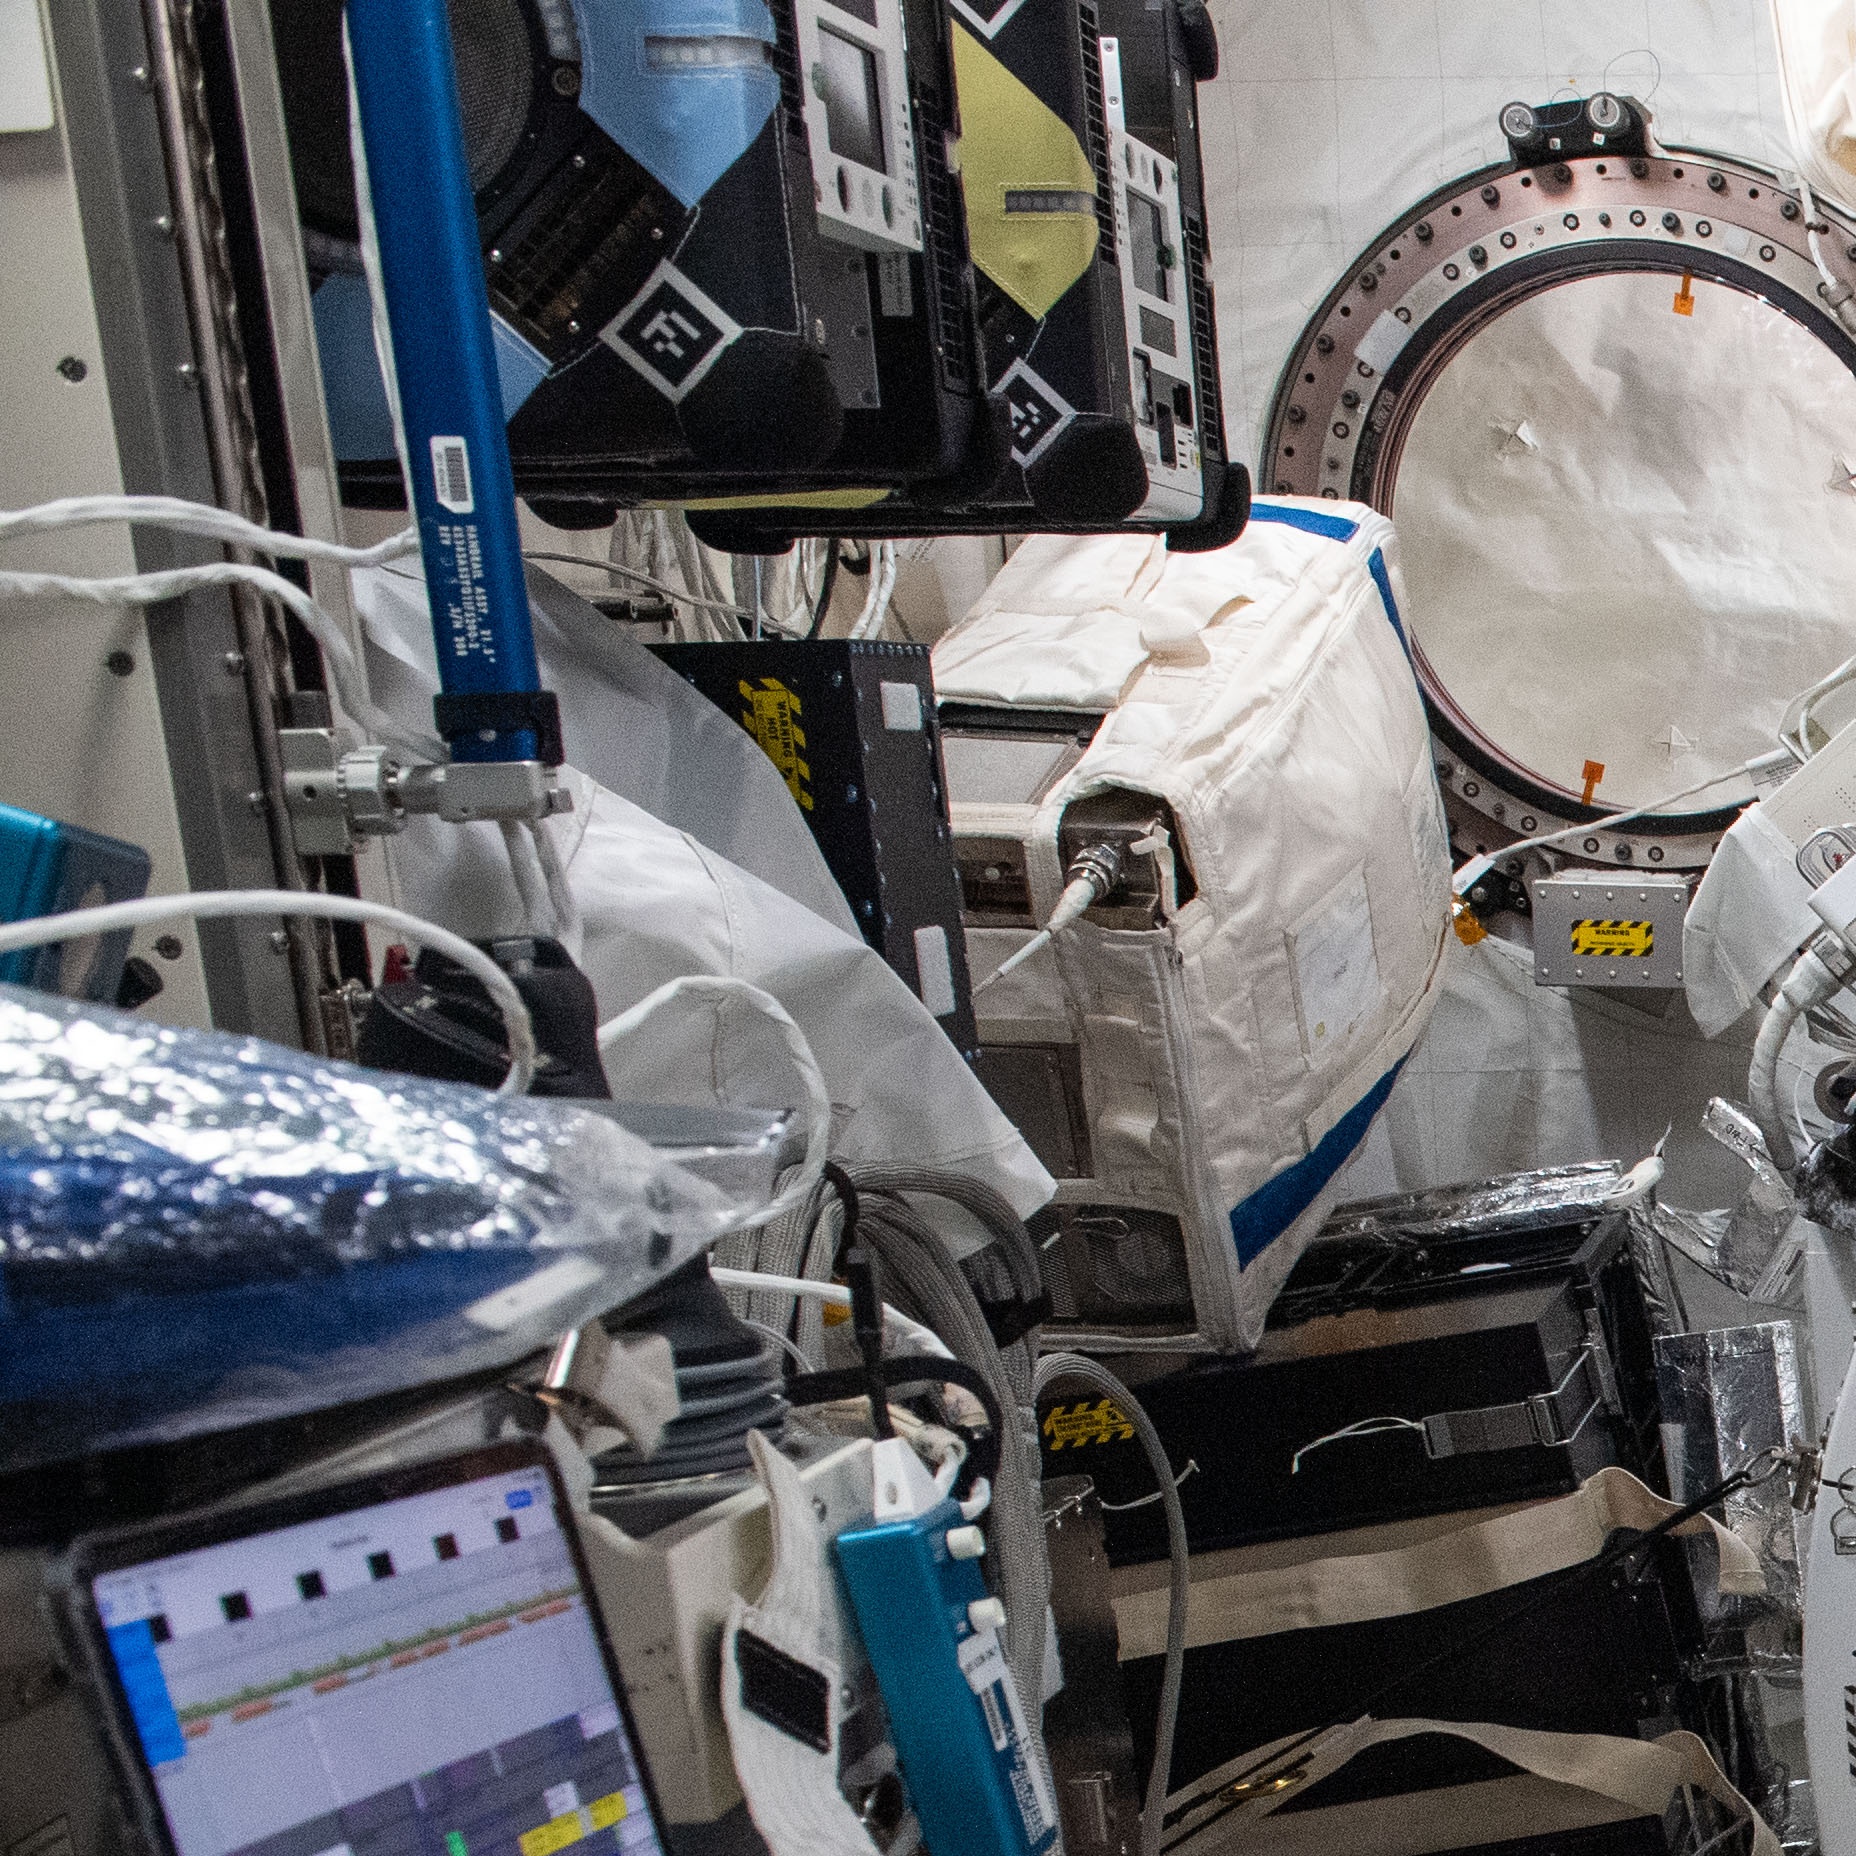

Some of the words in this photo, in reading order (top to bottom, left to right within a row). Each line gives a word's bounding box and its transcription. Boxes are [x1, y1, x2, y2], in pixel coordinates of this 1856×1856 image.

[466, 524, 483, 580] HANDRAIL
[766, 717, 779, 741] HOT
[776, 700, 793, 759] WARNING
[1594, 928, 1631, 937] WARNING
